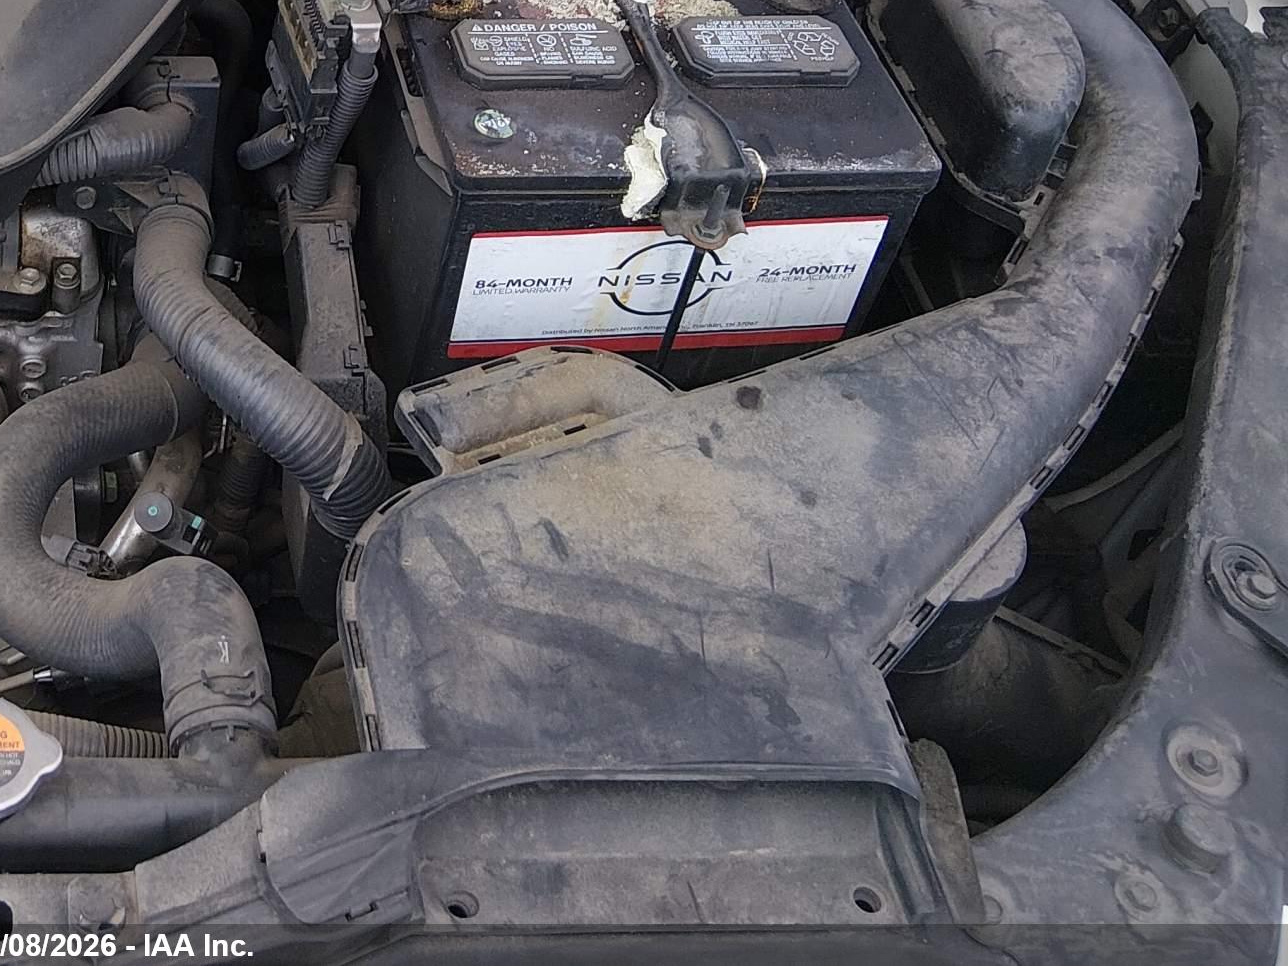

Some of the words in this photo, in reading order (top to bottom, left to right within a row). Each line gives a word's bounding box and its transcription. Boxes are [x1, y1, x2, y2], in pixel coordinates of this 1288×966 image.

[484, 24, 537, 32] DANGER
[549, 23, 597, 31] POISON
[759, 264, 857, 277] 24-MONTH
[475, 277, 573, 289] 84-MONTH
[756, 274, 779, 283] FREE
[781, 272, 852, 283] REPLACEMENT
[472, 286, 513, 296] LIMITED
[514, 286, 572, 294] WARRANTY
